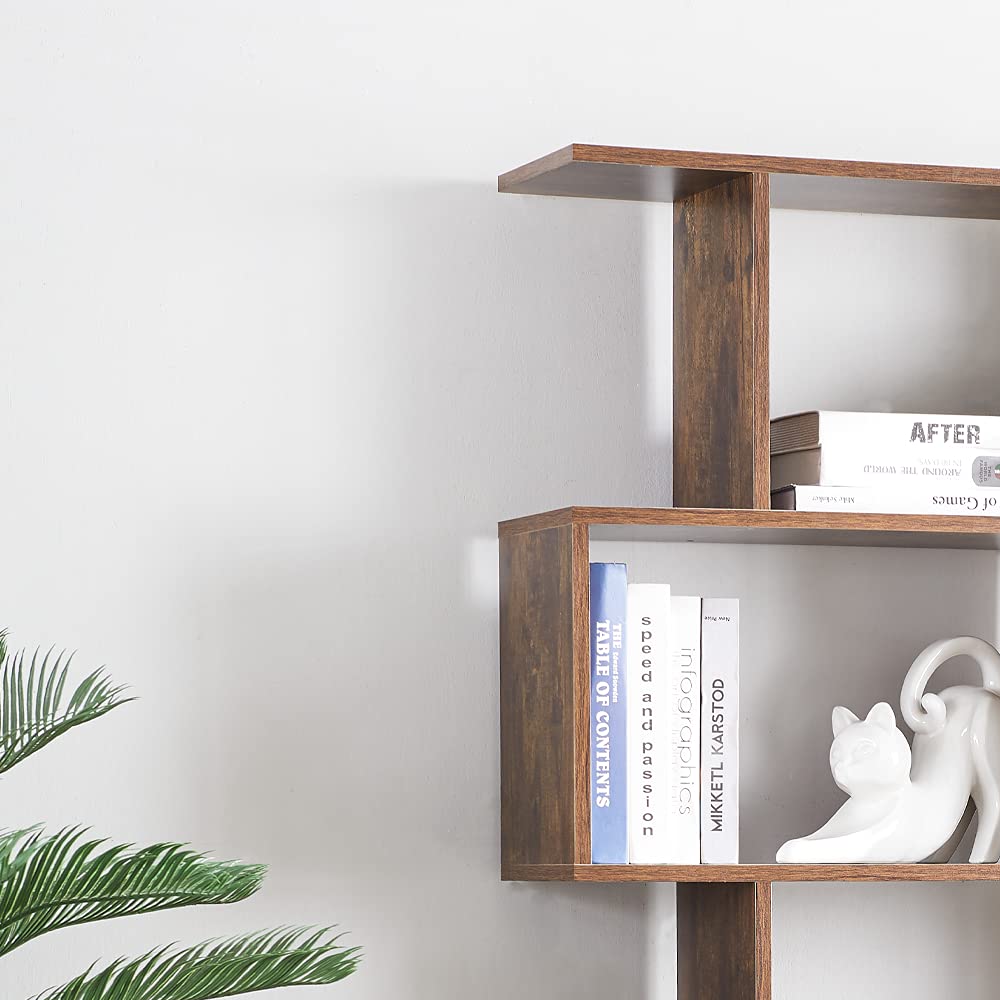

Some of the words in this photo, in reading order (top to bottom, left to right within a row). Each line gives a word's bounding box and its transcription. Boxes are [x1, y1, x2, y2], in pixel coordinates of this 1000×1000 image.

[909, 421, 981, 445] AFTER
[863, 464, 897, 475] WORLD
[901, 465, 919, 475] THE
[922, 464, 962, 476] AROUND
[932, 496, 979, 510] Games
[981, 497, 997, 511] of
[596, 620, 610, 676] TABLE
[612, 623, 622, 649] THE
[641, 616, 653, 683] speed
[596, 681, 610, 707] OF
[641, 693, 653, 731] and
[711, 678, 725, 756] KARSTOD
[678, 648, 697, 815] infographics
[596, 710, 611, 808] CONTENTS
[642, 741, 654, 836] passion
[711, 761, 724, 832] MIKKETL
